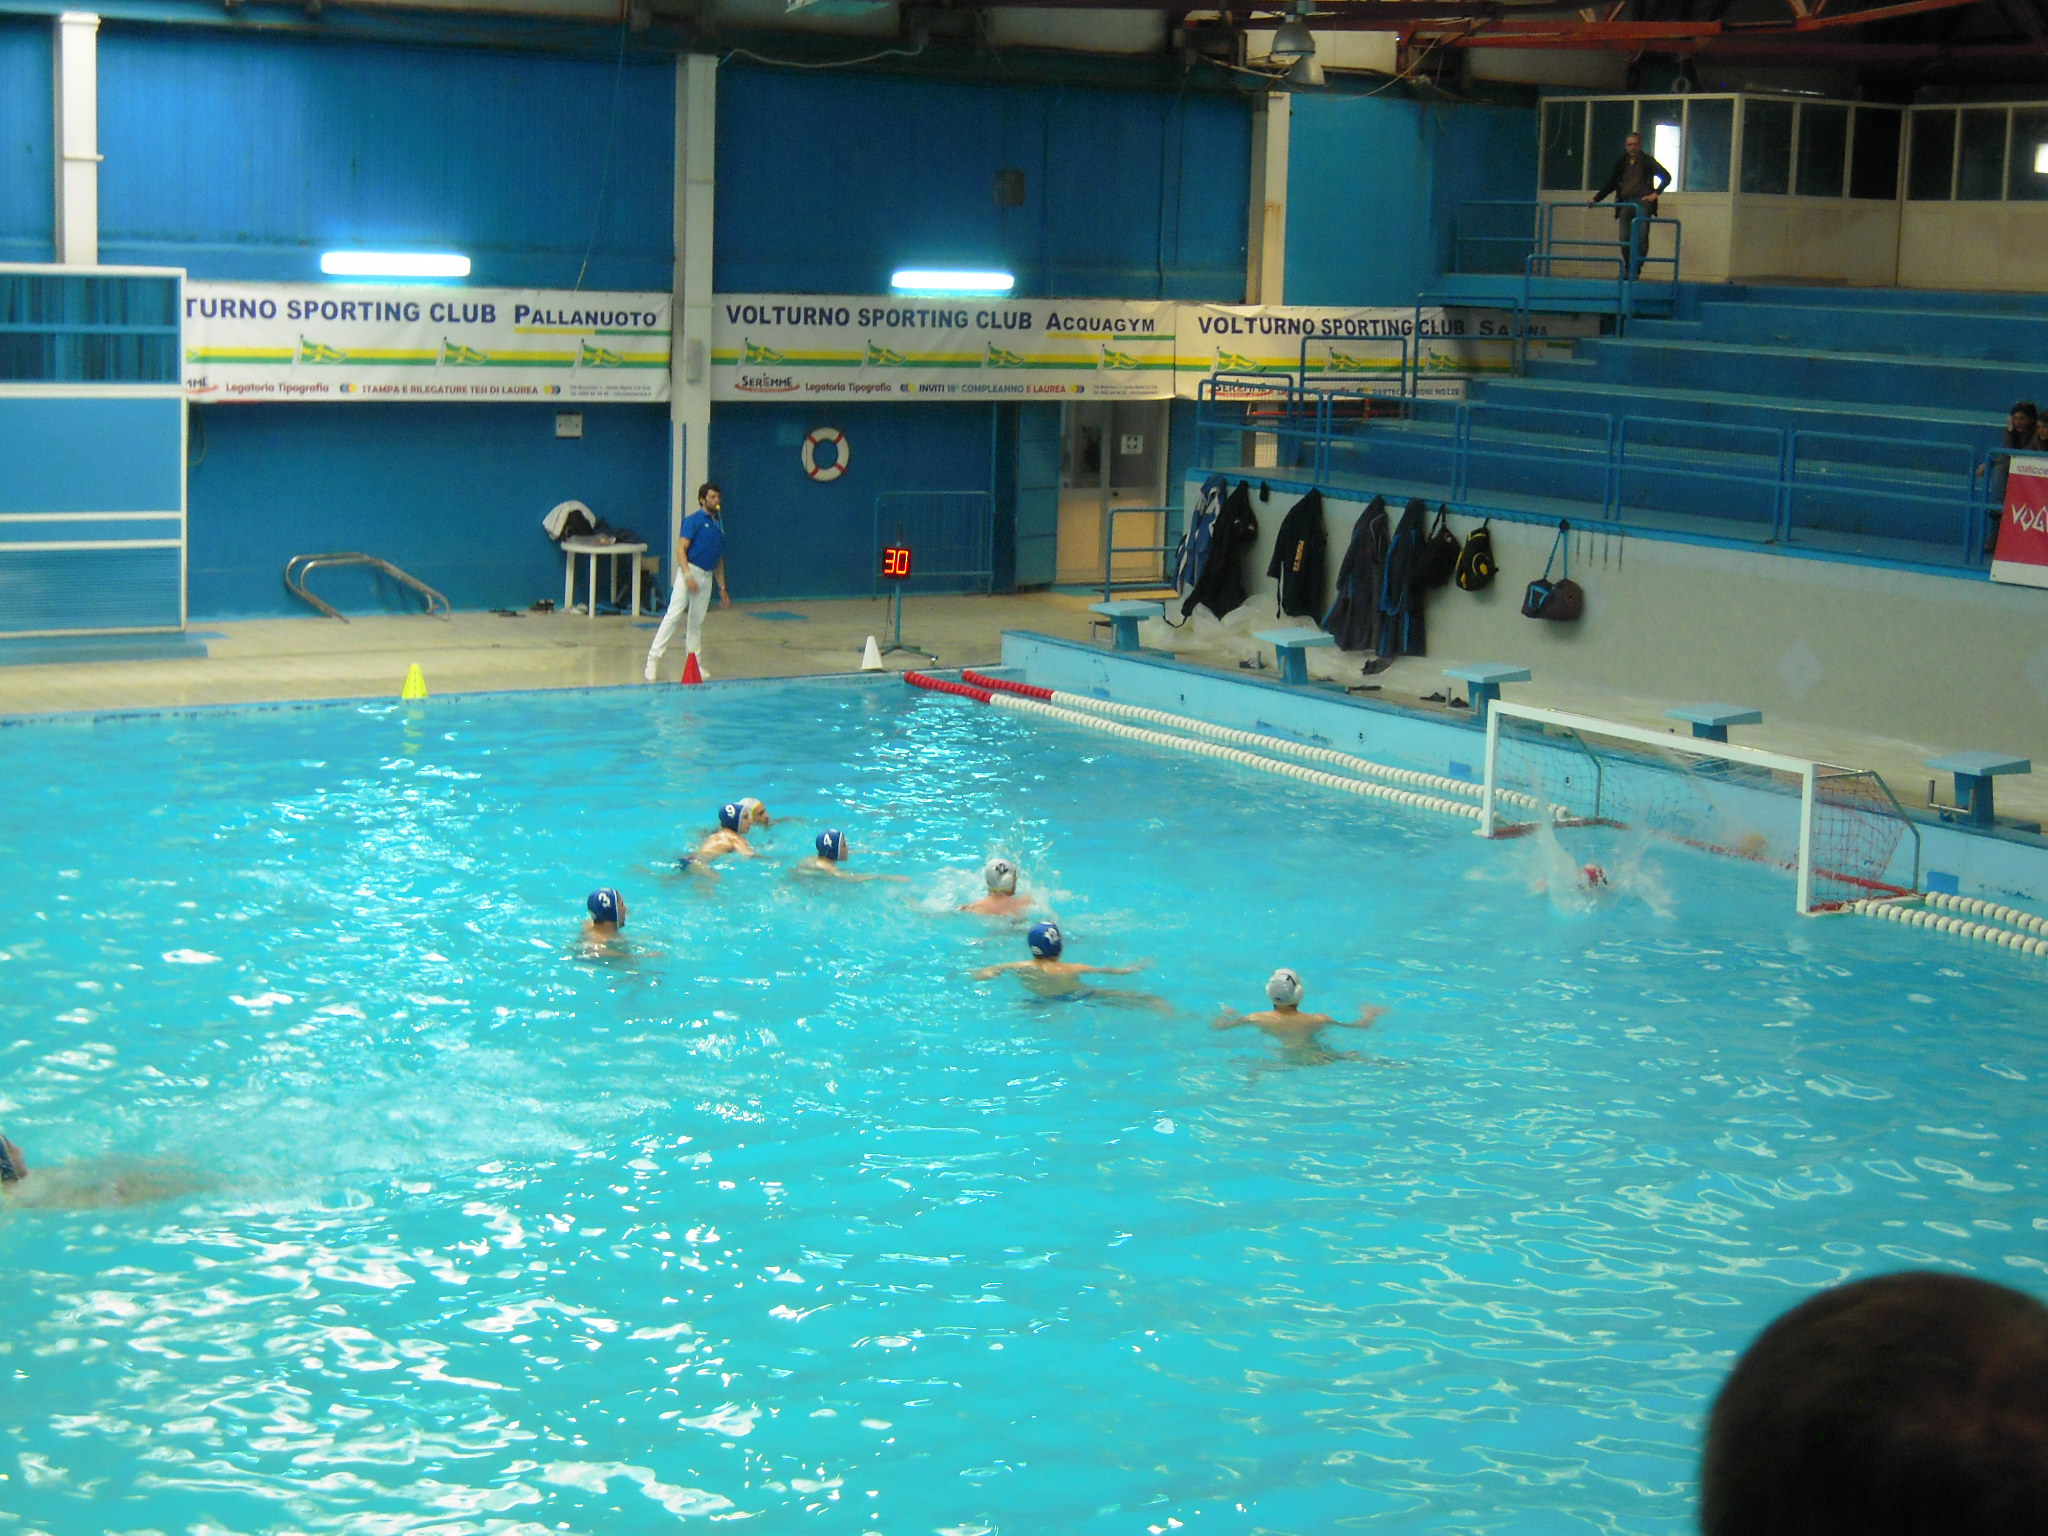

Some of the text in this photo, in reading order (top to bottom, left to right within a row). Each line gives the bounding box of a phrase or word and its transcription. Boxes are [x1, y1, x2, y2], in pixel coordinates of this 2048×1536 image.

[287, 300, 420, 322] SPORTING
[430, 302, 496, 324] CLUB
[514, 304, 657, 326] PALLANUOTO
[726, 305, 1155, 332] VOLTURNO SPORTING CLUB ACQUAGYM
[1198, 317, 1315, 335] VOLTURNO
[1321, 318, 1412, 336] SPORTING
[1419, 319, 1465, 335] CLUB
[226, 382, 330, 395] Legatoria Tipografia
[362, 384, 400, 394] STAMPA
[402, 385, 408, 394] E
[410, 385, 467, 394] RILEGATURE
[490, 385, 499, 394] DI
[502, 385, 539, 394] LAUREA
[805, 382, 892, 394] Legatoria Tipografia
[919, 384, 945, 393] INVITI
[961, 384, 1024, 394] COMPLEANNO
[1026, 385, 1031, 394] E
[1033, 385, 1066, 394] LAUREA
[2011, 502, 2048, 532] VOG
[884, 548, 909, 574] 30
[725, 804, 736, 818] 9
[823, 833, 833, 847] 4
[598, 892, 611, 908] 3
